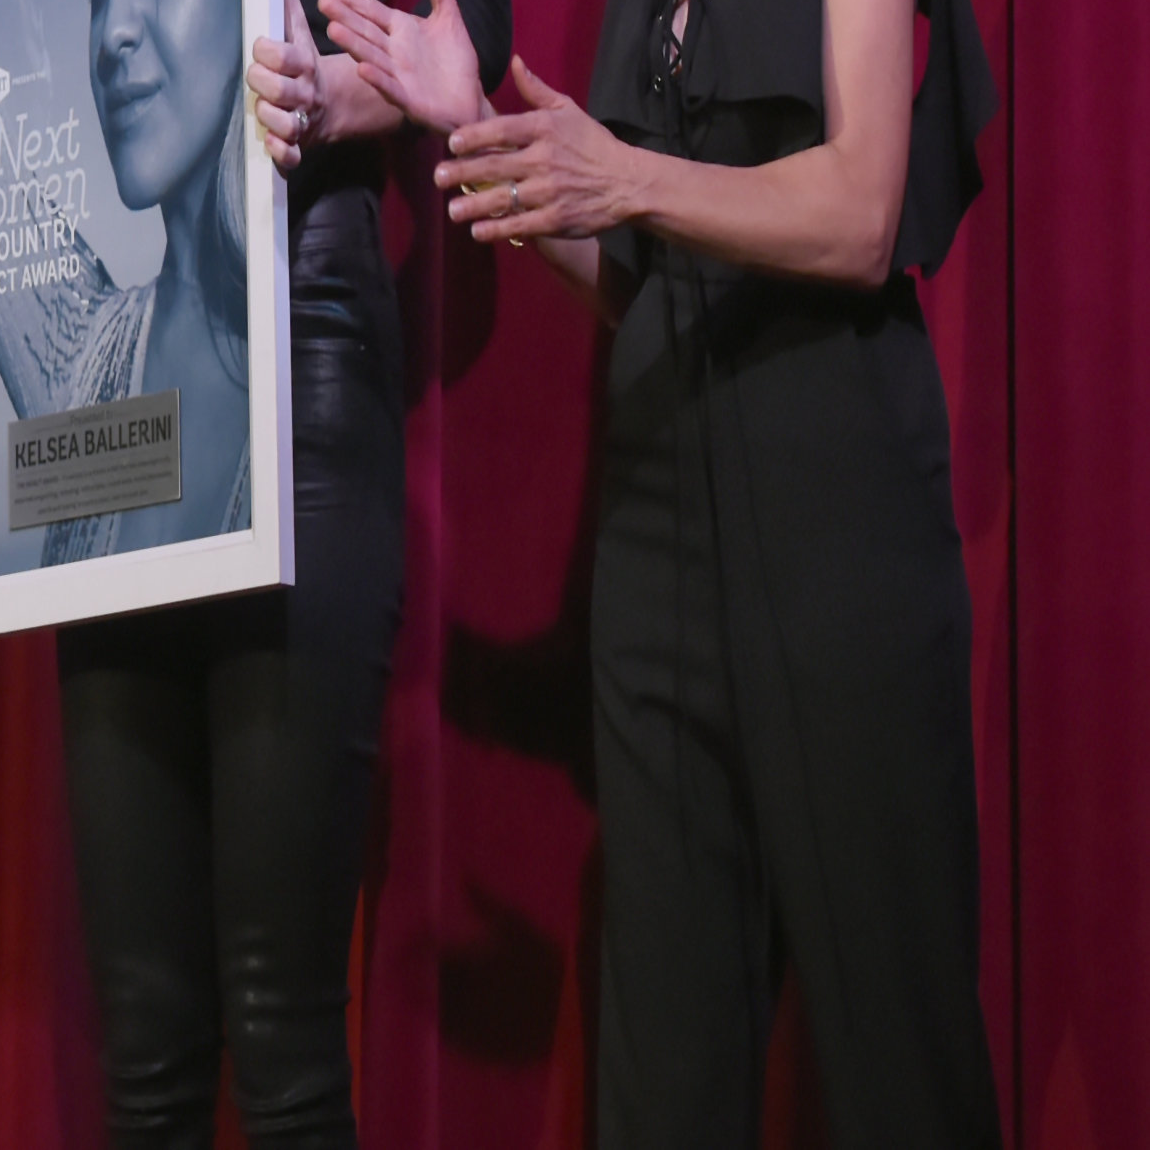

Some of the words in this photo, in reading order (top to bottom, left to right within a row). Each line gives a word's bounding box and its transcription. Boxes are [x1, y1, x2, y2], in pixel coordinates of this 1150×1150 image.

[21, 253, 80, 290] AWARD
[15, 432, 80, 470] KELSEA
[84, 414, 172, 456] BALLERINI
